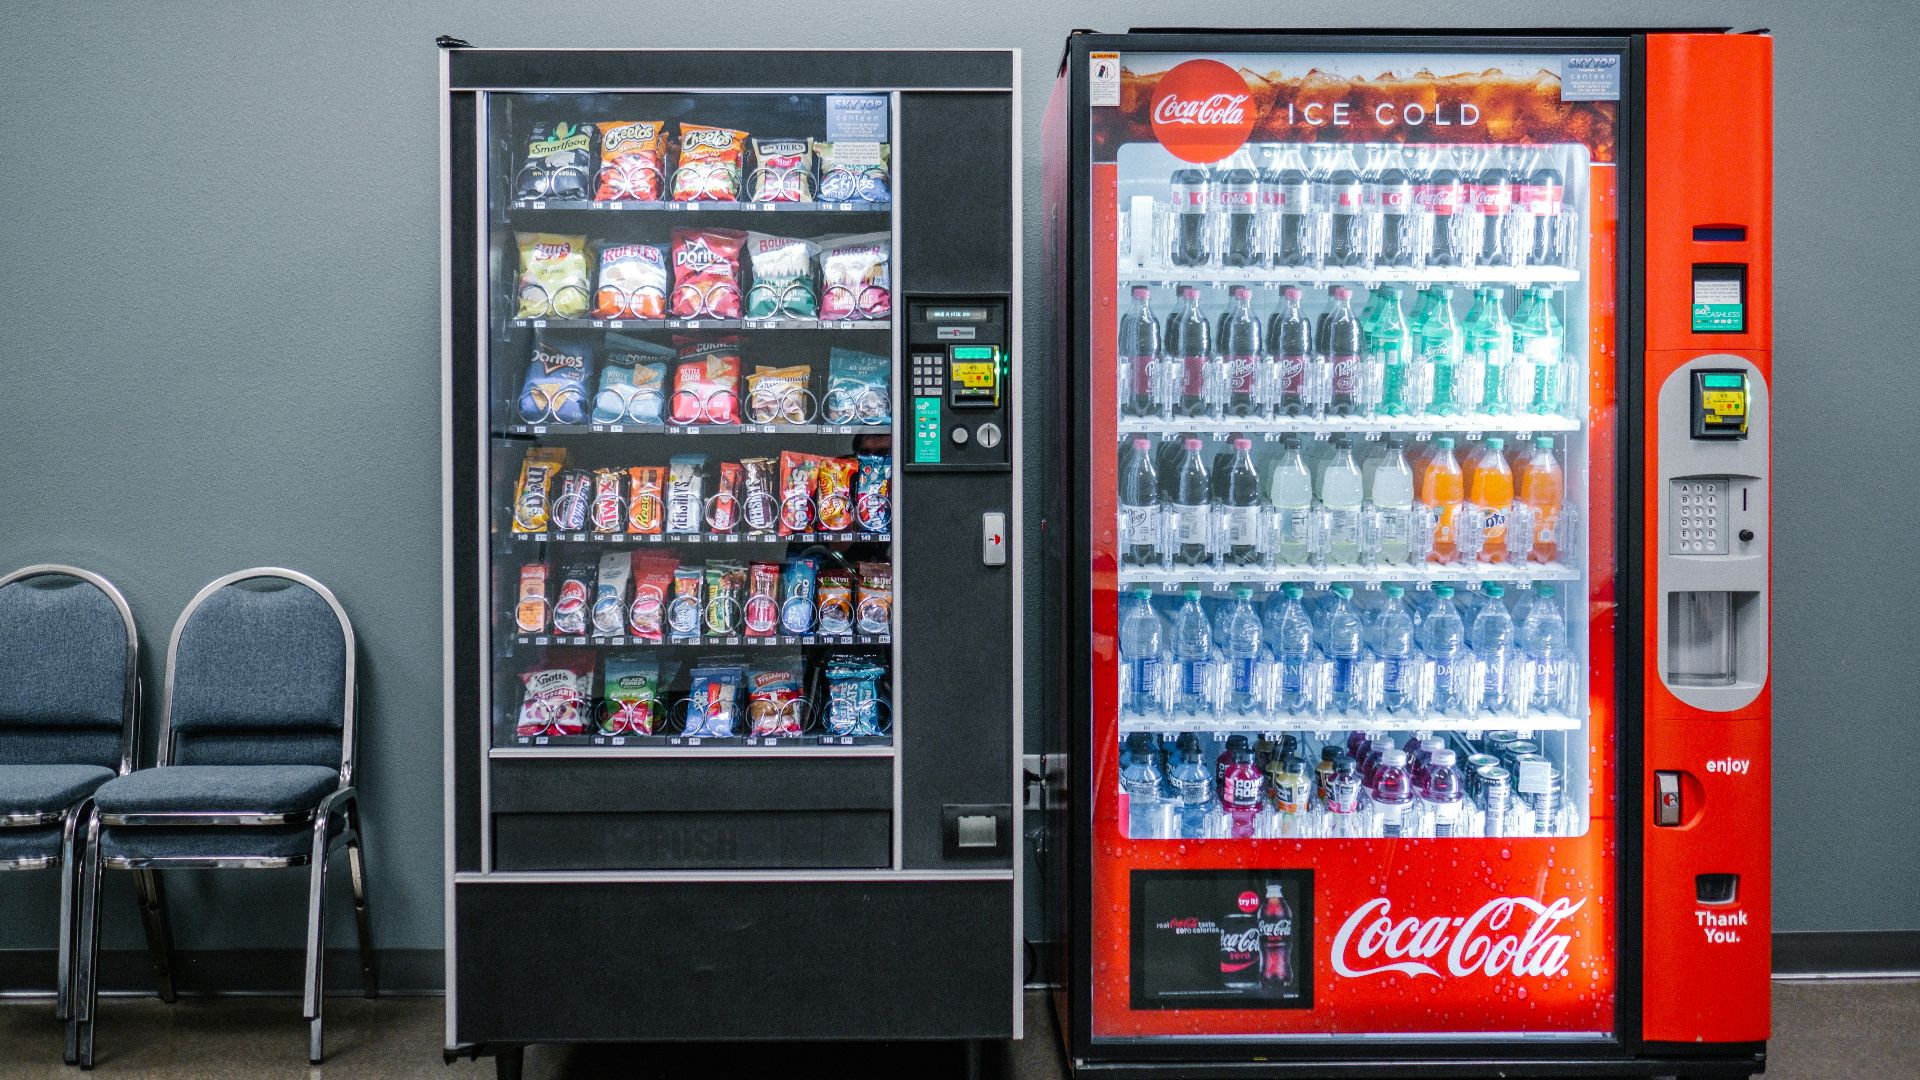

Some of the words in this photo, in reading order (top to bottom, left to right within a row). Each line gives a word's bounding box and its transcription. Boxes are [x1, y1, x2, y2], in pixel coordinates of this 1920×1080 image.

[1154, 93, 1249, 125] Coca-Cola
[1288, 102, 1350, 126] ICE
[1375, 102, 1480, 126] COLD
[604, 124, 655, 151] Cheetos
[683, 130, 734, 151] Cheetos
[531, 138, 587, 154] Smartfood
[1221, 192, 1248, 205] Coke
[603, 245, 658, 262] RUFFLES
[570, 481, 592, 528] SNICKERS
[1706, 757, 1750, 775] enjoy
[1238, 898, 1250, 906] try
[1250, 897, 1258, 905] it!
[1156, 921, 1170, 929] real
[1695, 911, 1748, 927] Thank
[1175, 927, 1192, 935] zero
[1331, 896, 1587, 979] Coca-Cola
[1704, 928, 1741, 944] You.
[1229, 952, 1251, 960] zero
